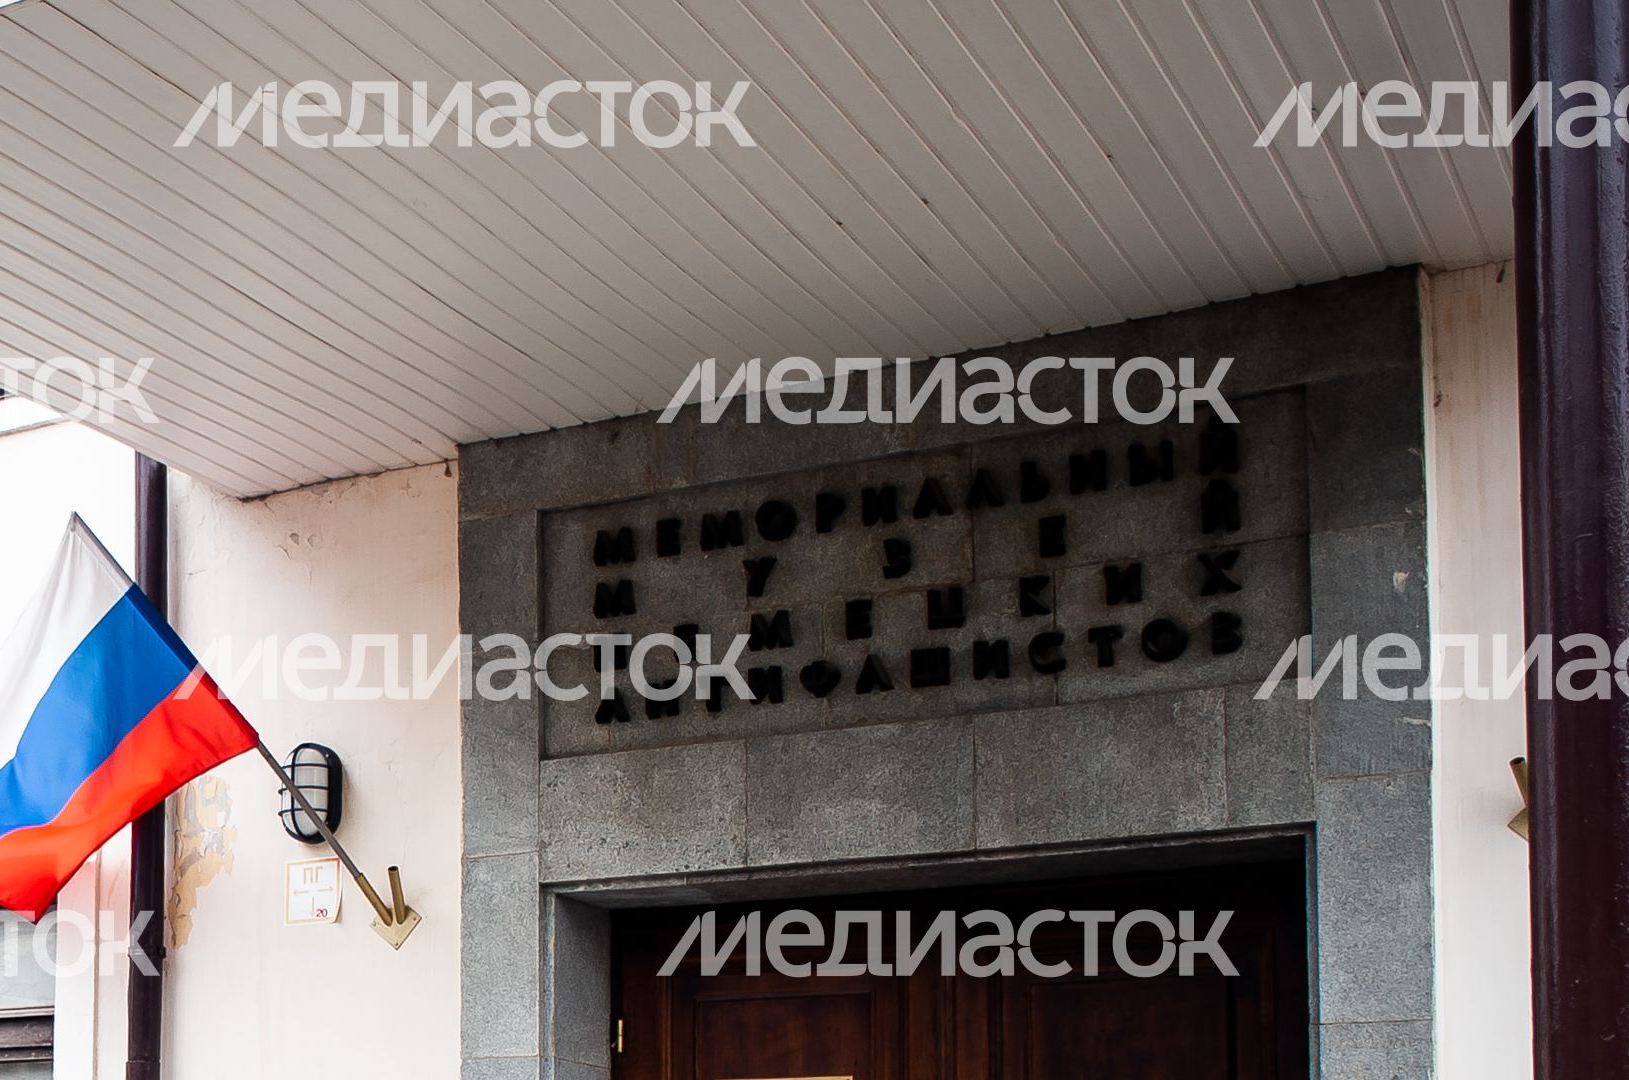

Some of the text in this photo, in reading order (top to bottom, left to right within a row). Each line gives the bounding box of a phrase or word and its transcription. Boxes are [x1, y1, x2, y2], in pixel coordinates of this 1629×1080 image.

[593, 415, 1240, 566] МЕМОРИАЛЬНЫЙ
[593, 478, 1241, 619] МУЗЕЙ
[594, 611, 1242, 724] АНТИФАШИСТОВ
[303, 866, 323, 884] ПГ
[316, 908, 328, 918] 20
